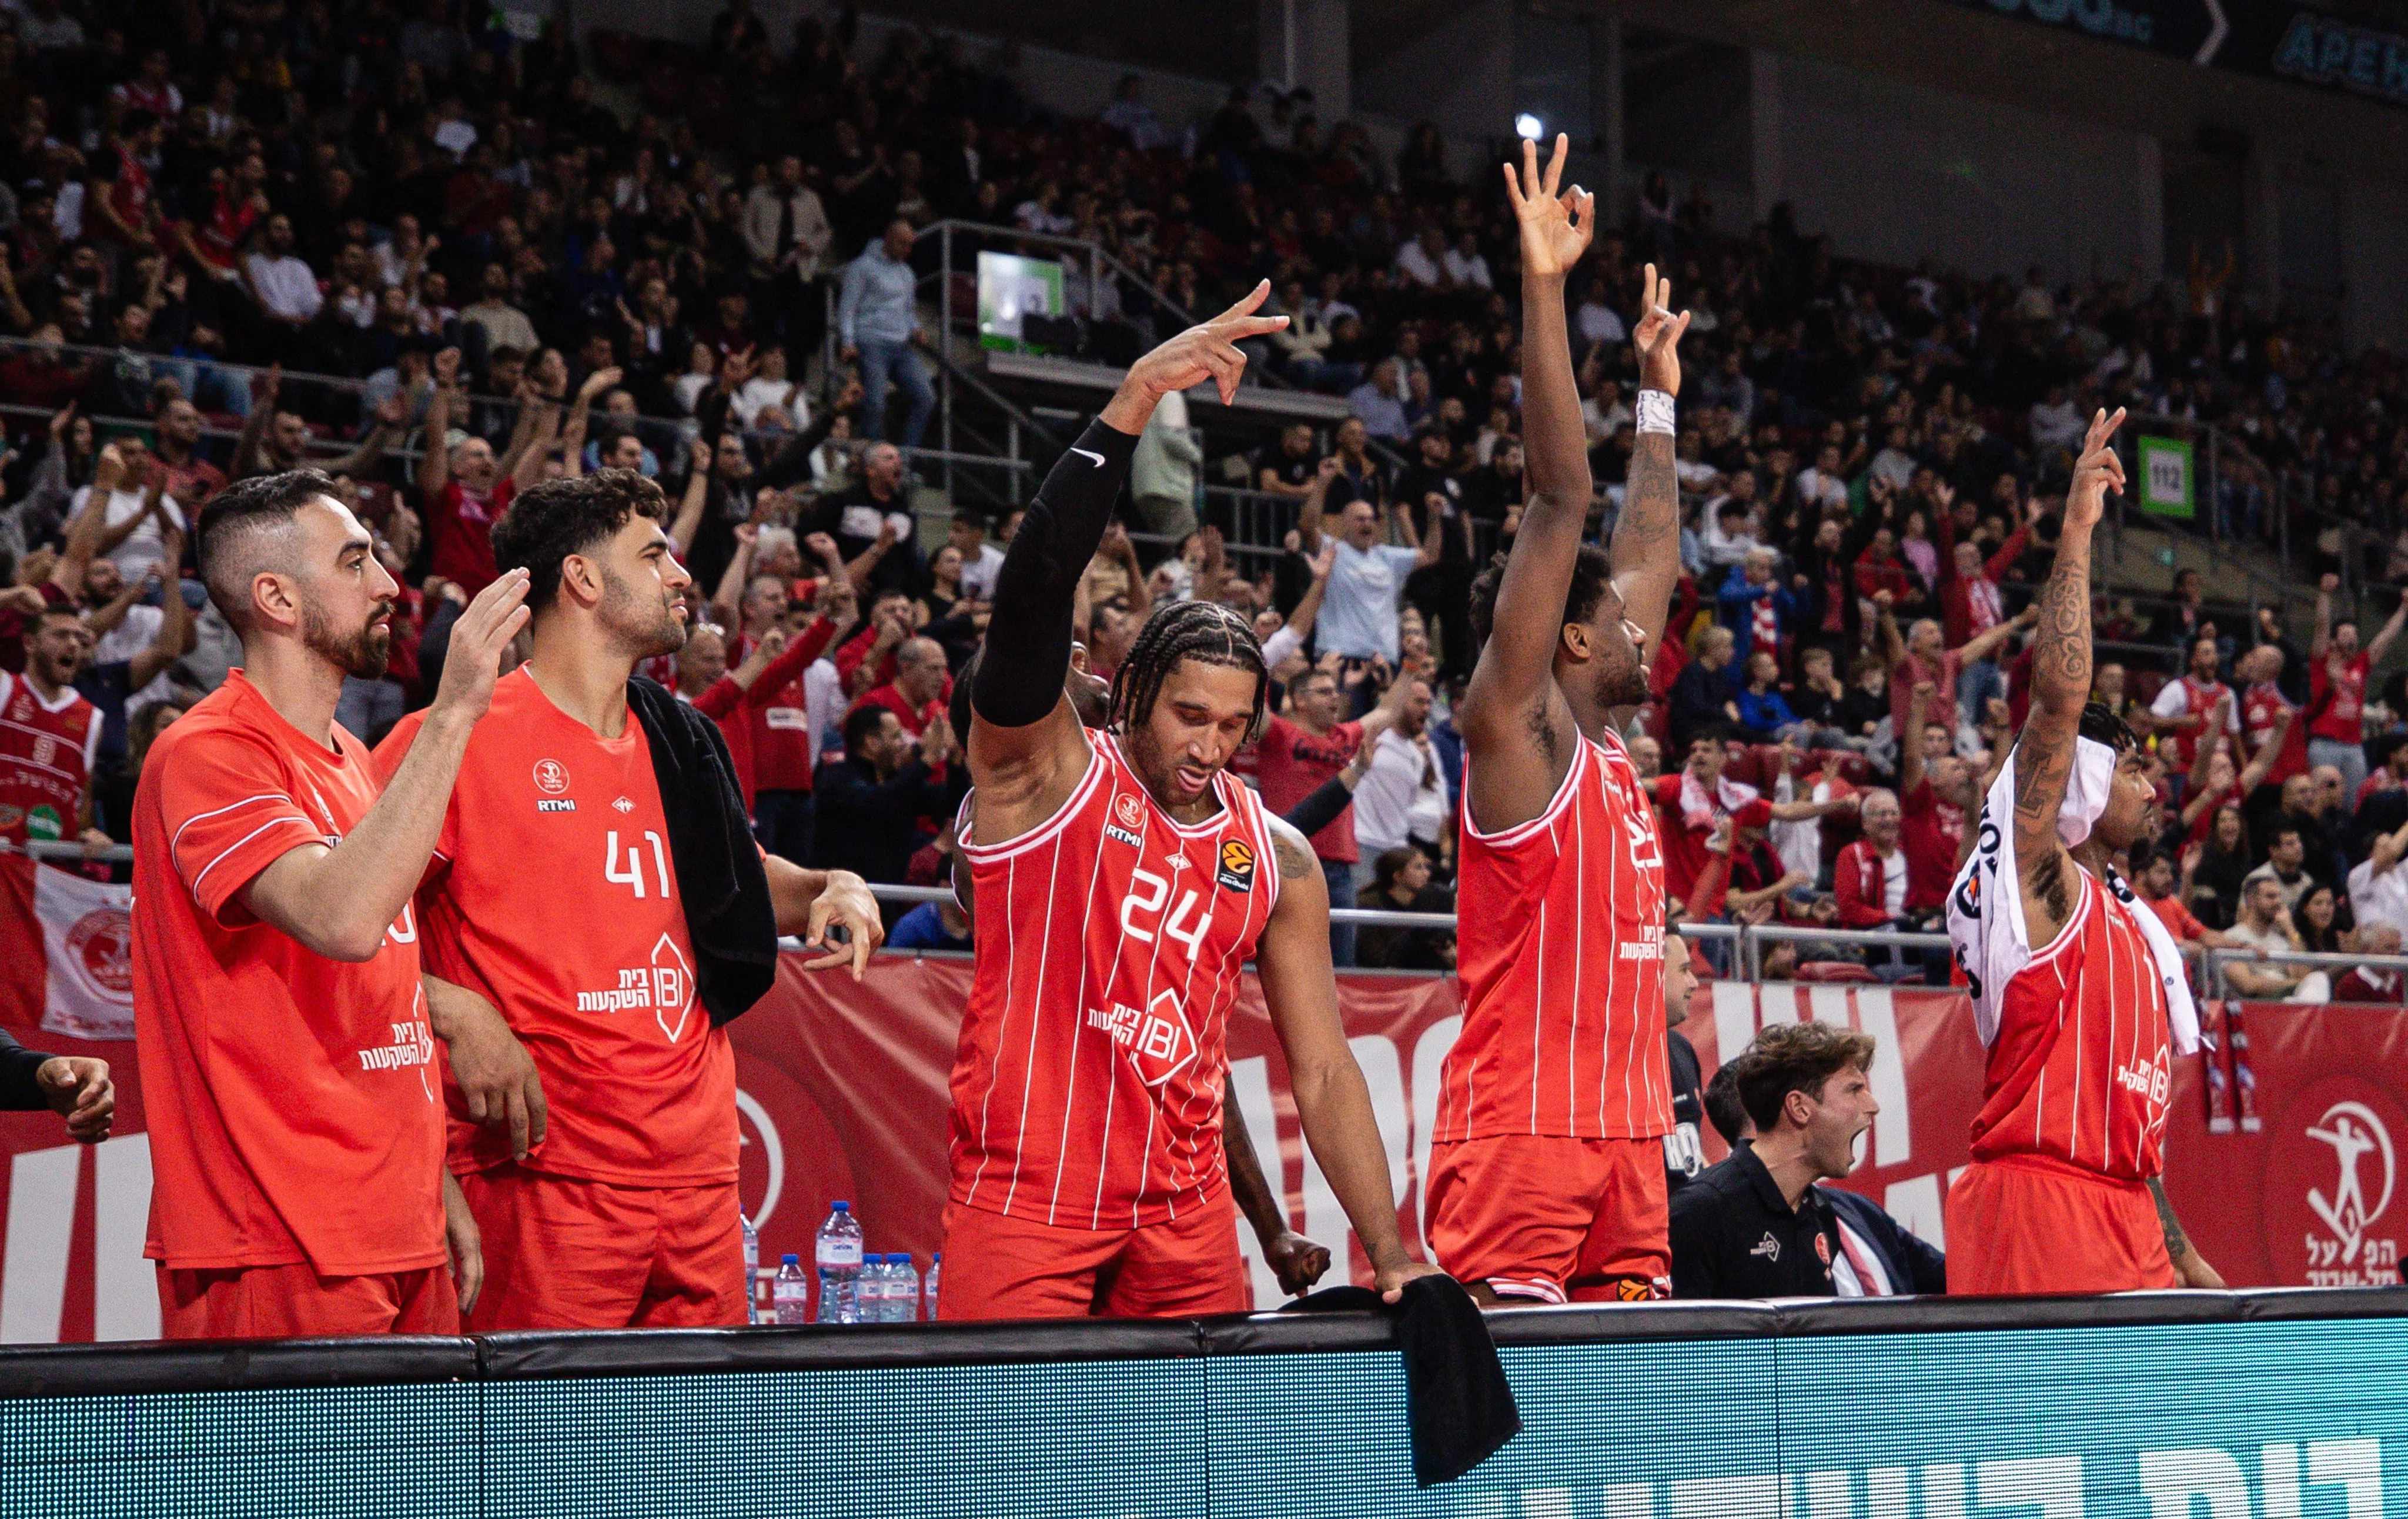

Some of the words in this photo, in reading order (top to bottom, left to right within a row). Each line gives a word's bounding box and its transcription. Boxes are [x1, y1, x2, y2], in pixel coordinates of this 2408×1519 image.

[2152, 464, 2180, 490] 112
[537, 800, 576, 811] RTMI
[1106, 824, 1142, 847] RTMI
[605, 830, 670, 898] 41
[1121, 867, 1212, 962] 24
[1620, 942, 1657, 962] השקעות
[619, 968, 649, 989] בית
[652, 967, 683, 1007] IBI
[577, 989, 650, 1013] השקעות
[1087, 1008, 1135, 1046] השעות
[1112, 1003, 1142, 1029] בית
[392, 1021, 417, 1044] בית
[1136, 1014, 1182, 1063] IBI
[358, 1044, 419, 1070] השקעות
